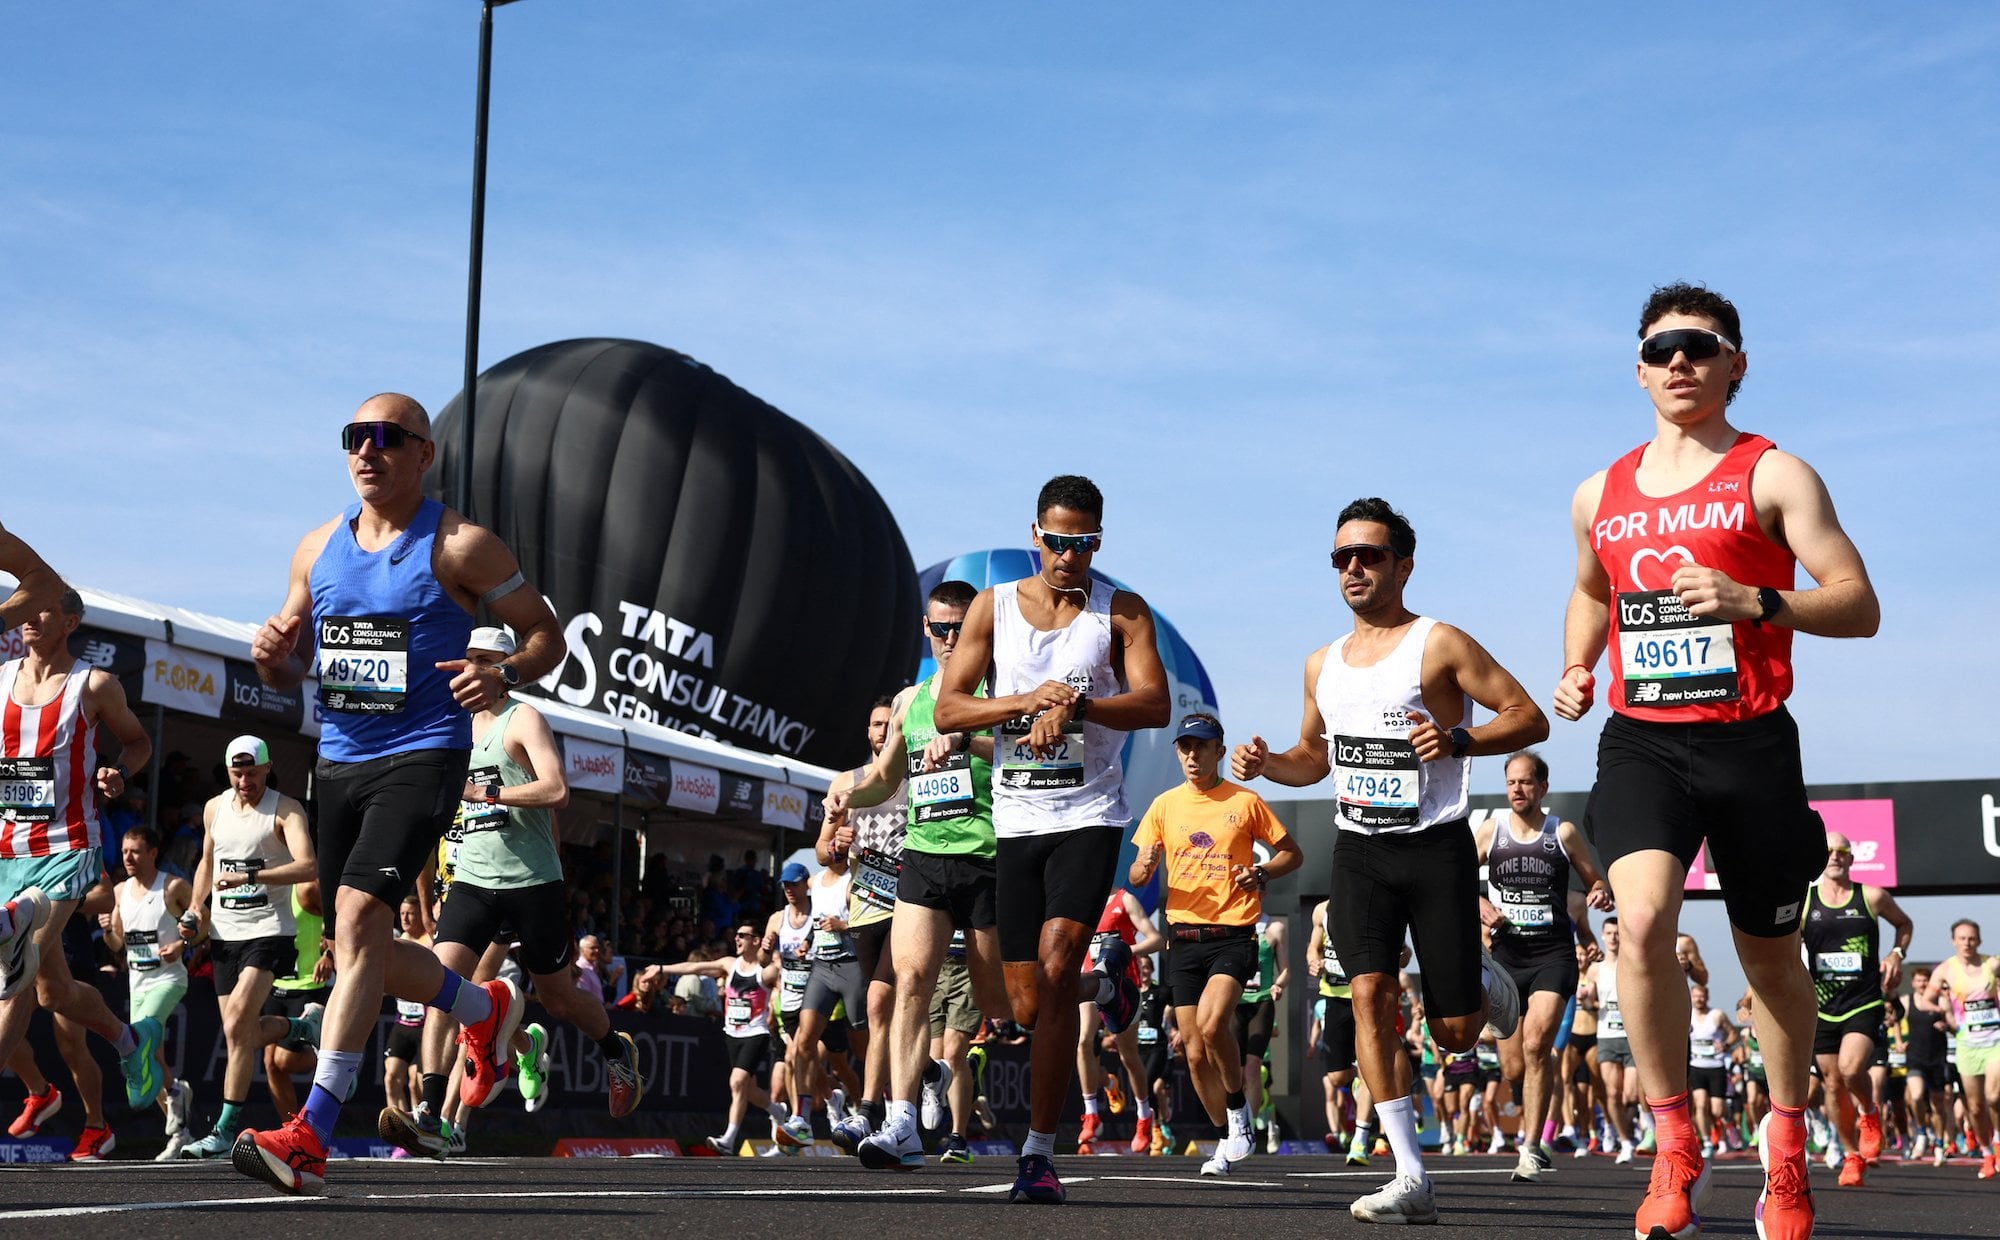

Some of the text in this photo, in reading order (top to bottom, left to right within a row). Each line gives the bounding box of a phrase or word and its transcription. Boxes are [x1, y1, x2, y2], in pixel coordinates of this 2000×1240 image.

[1595, 502, 1745, 549] FOR MUM
[1621, 599, 1655, 625] tcs
[322, 621, 350, 644] tcs
[352, 630, 402, 638] CONSULTANCY
[619, 600, 713, 668] TATA
[1634, 636, 1711, 668] 49617
[328, 657, 389, 682] 49720
[233, 677, 259, 707] tcs
[609, 648, 815, 754] CONSULTANCY
[1663, 692, 1682, 701] new
[1684, 688, 1727, 699] balance
[361, 702, 395, 710] balance
[1015, 741, 1068, 760] 4302
[1338, 740, 1363, 763] tcs
[1365, 750, 1411, 758] CONSULTANCY
[675, 775, 716, 800] HubSpot
[917, 776, 960, 798] 44968
[1031, 778, 1046, 786] new
[1047, 776, 1076, 786] balance
[1347, 774, 1401, 798] 47942
[4, 785, 43, 801] 51905
[943, 807, 969, 816] balance
[1378, 816, 1410, 824] balance
[1496, 858, 1519, 875] TYNE
[863, 871, 896, 893] 42582
[1503, 889, 1521, 903] tcs
[1509, 908, 1544, 920] 51068
